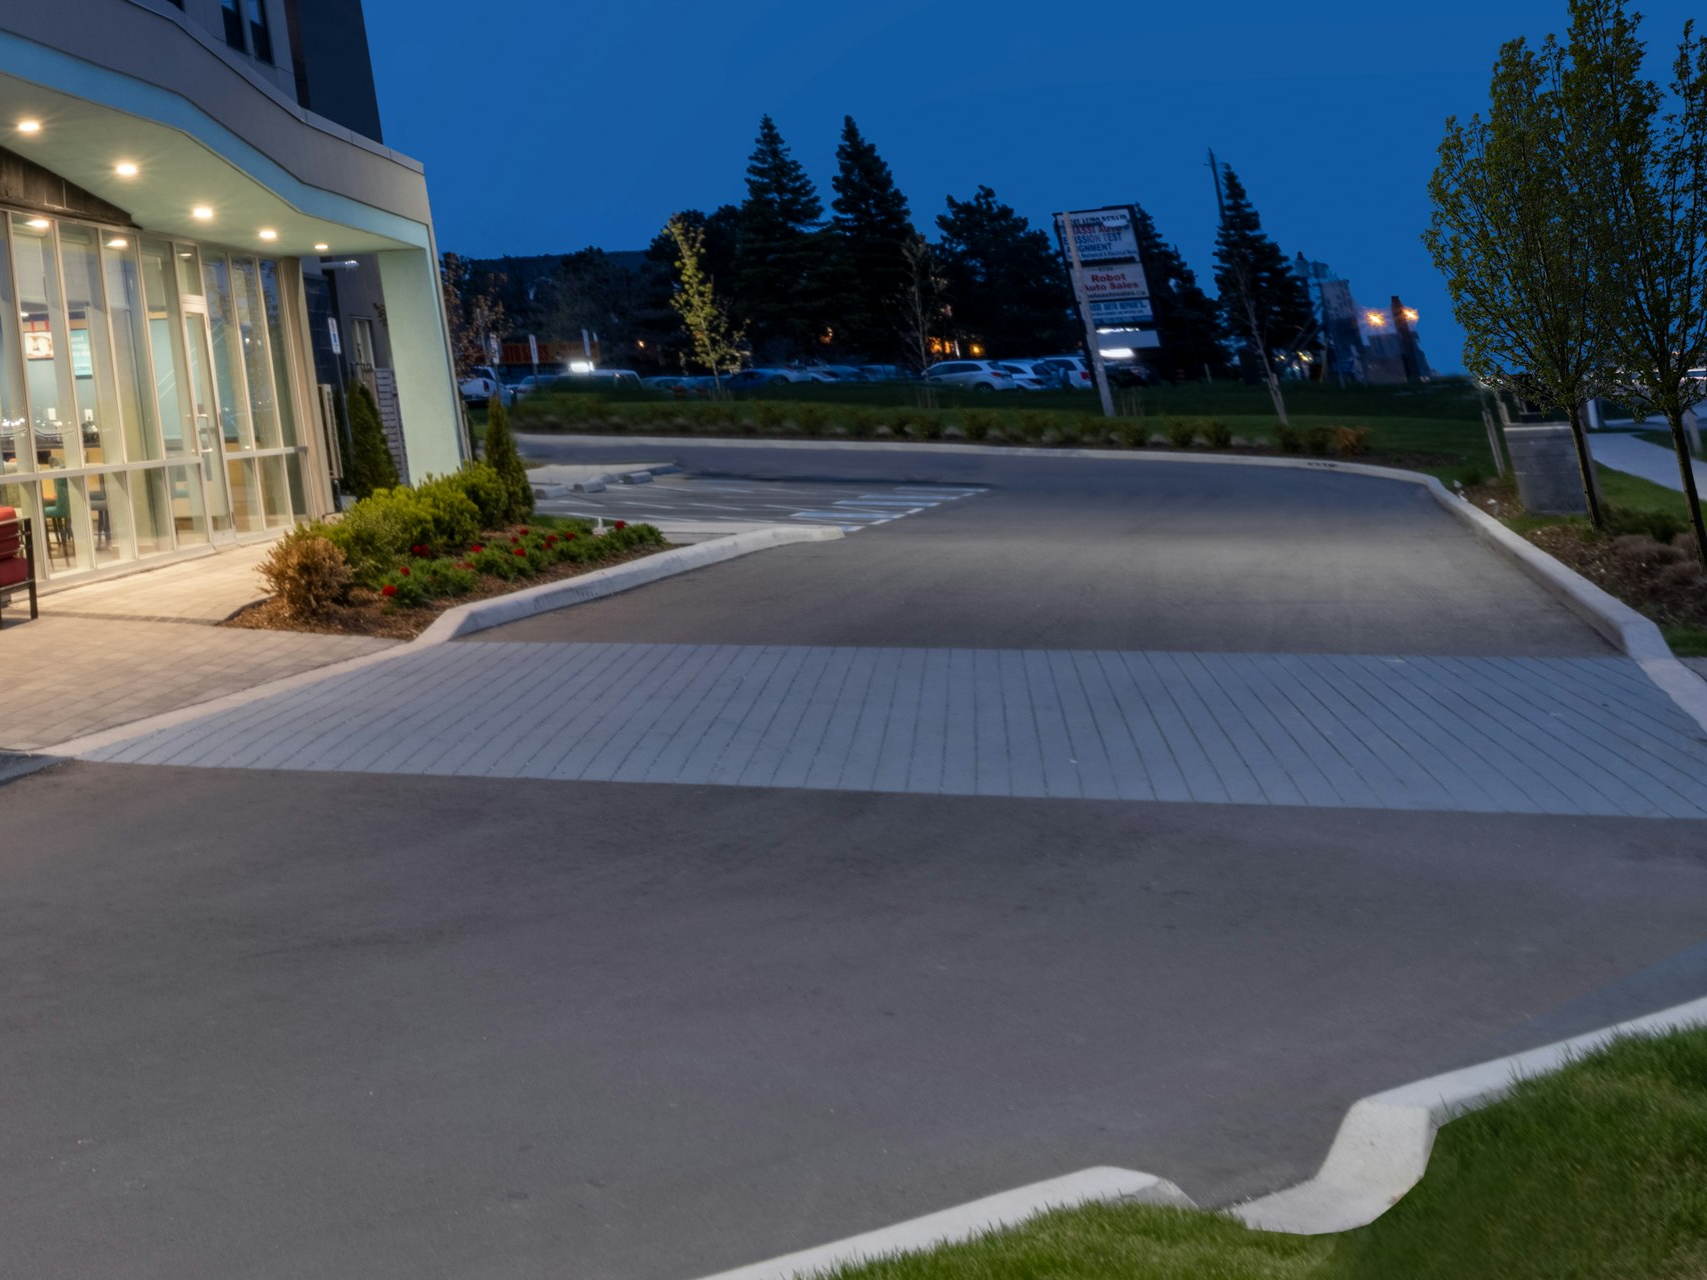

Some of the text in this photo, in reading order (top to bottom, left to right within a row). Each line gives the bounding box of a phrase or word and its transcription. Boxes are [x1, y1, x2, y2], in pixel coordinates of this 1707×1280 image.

[1063, 232, 1122, 245] EISSION TEST
[1066, 242, 1112, 253] AGNMENT
[1091, 272, 1126, 282] Robot
[1109, 281, 1139, 290] Sales
